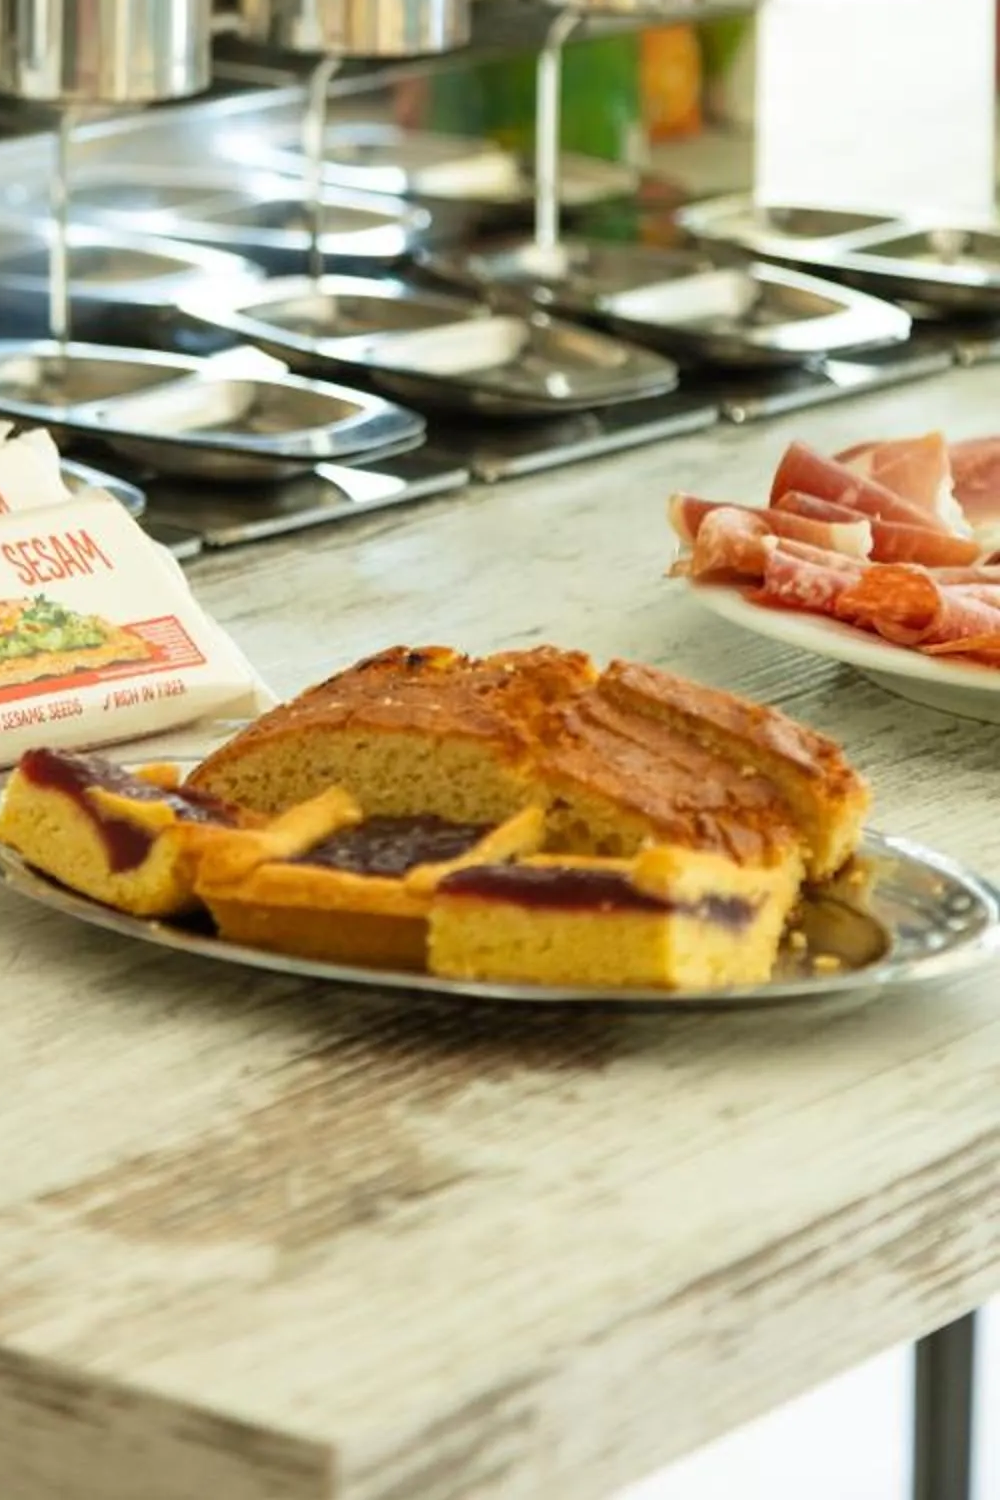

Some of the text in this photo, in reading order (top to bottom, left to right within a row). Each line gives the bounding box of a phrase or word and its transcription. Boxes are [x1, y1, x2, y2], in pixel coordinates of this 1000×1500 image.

[0, 529, 114, 586] SESAM
[114, 689, 139, 709] RICH
[142, 685, 155, 703] IN
[2, 705, 47, 732] SESAME
[49, 698, 84, 720] SEEDS
